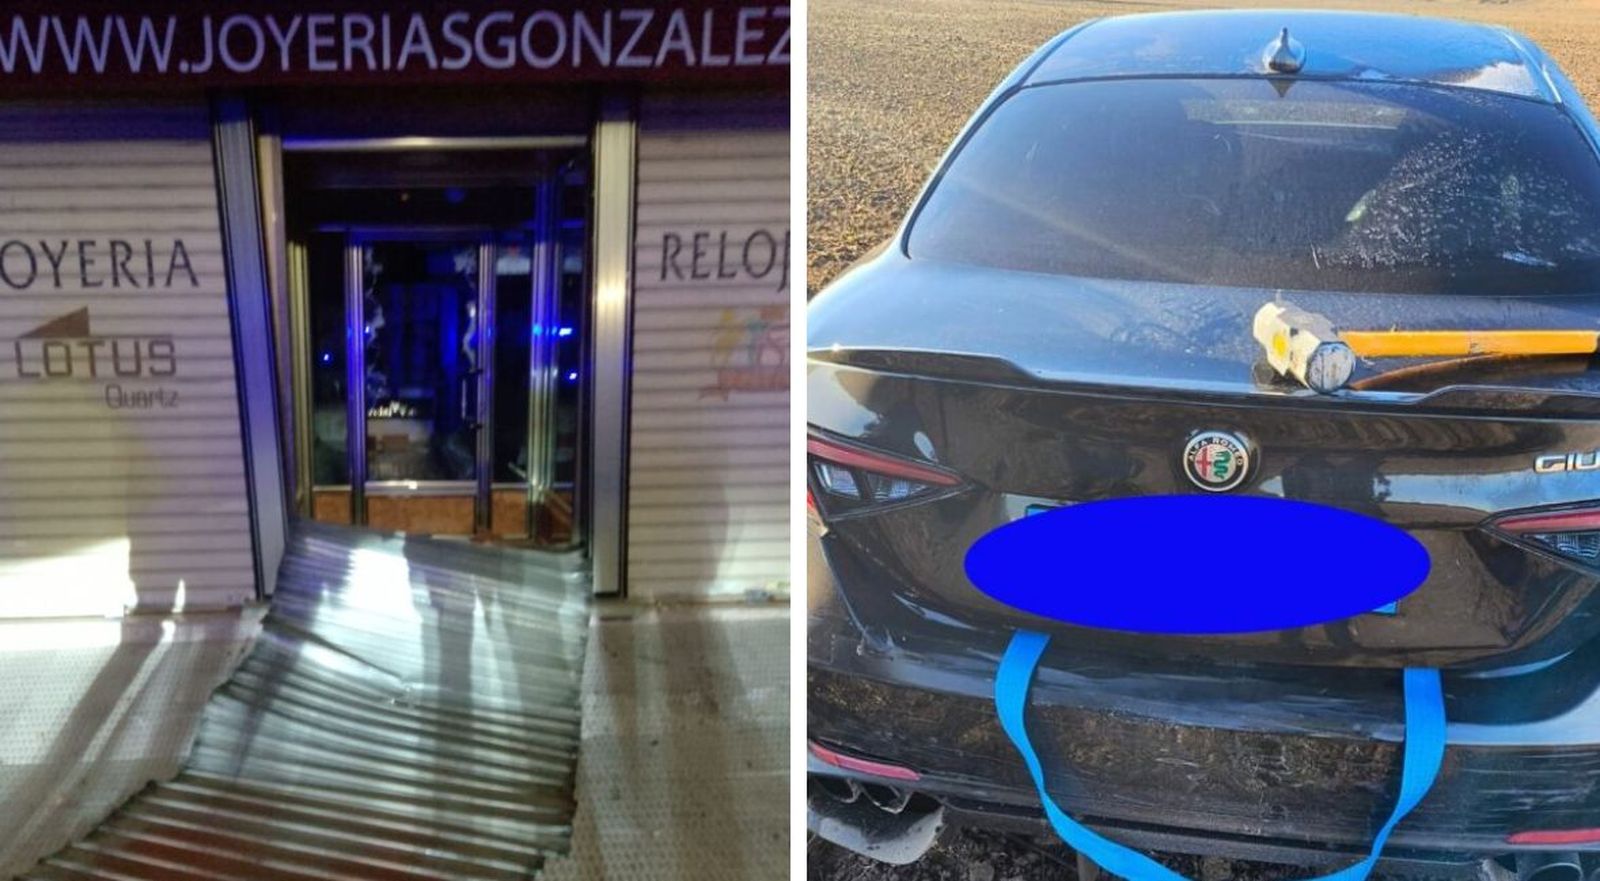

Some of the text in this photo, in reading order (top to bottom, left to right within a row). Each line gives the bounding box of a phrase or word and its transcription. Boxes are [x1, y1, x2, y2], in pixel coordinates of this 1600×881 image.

[15, 339, 177, 378] LOTUS
[105, 384, 179, 409] Quartz
[1189, 437, 1243, 466] ALFA ROMEO
